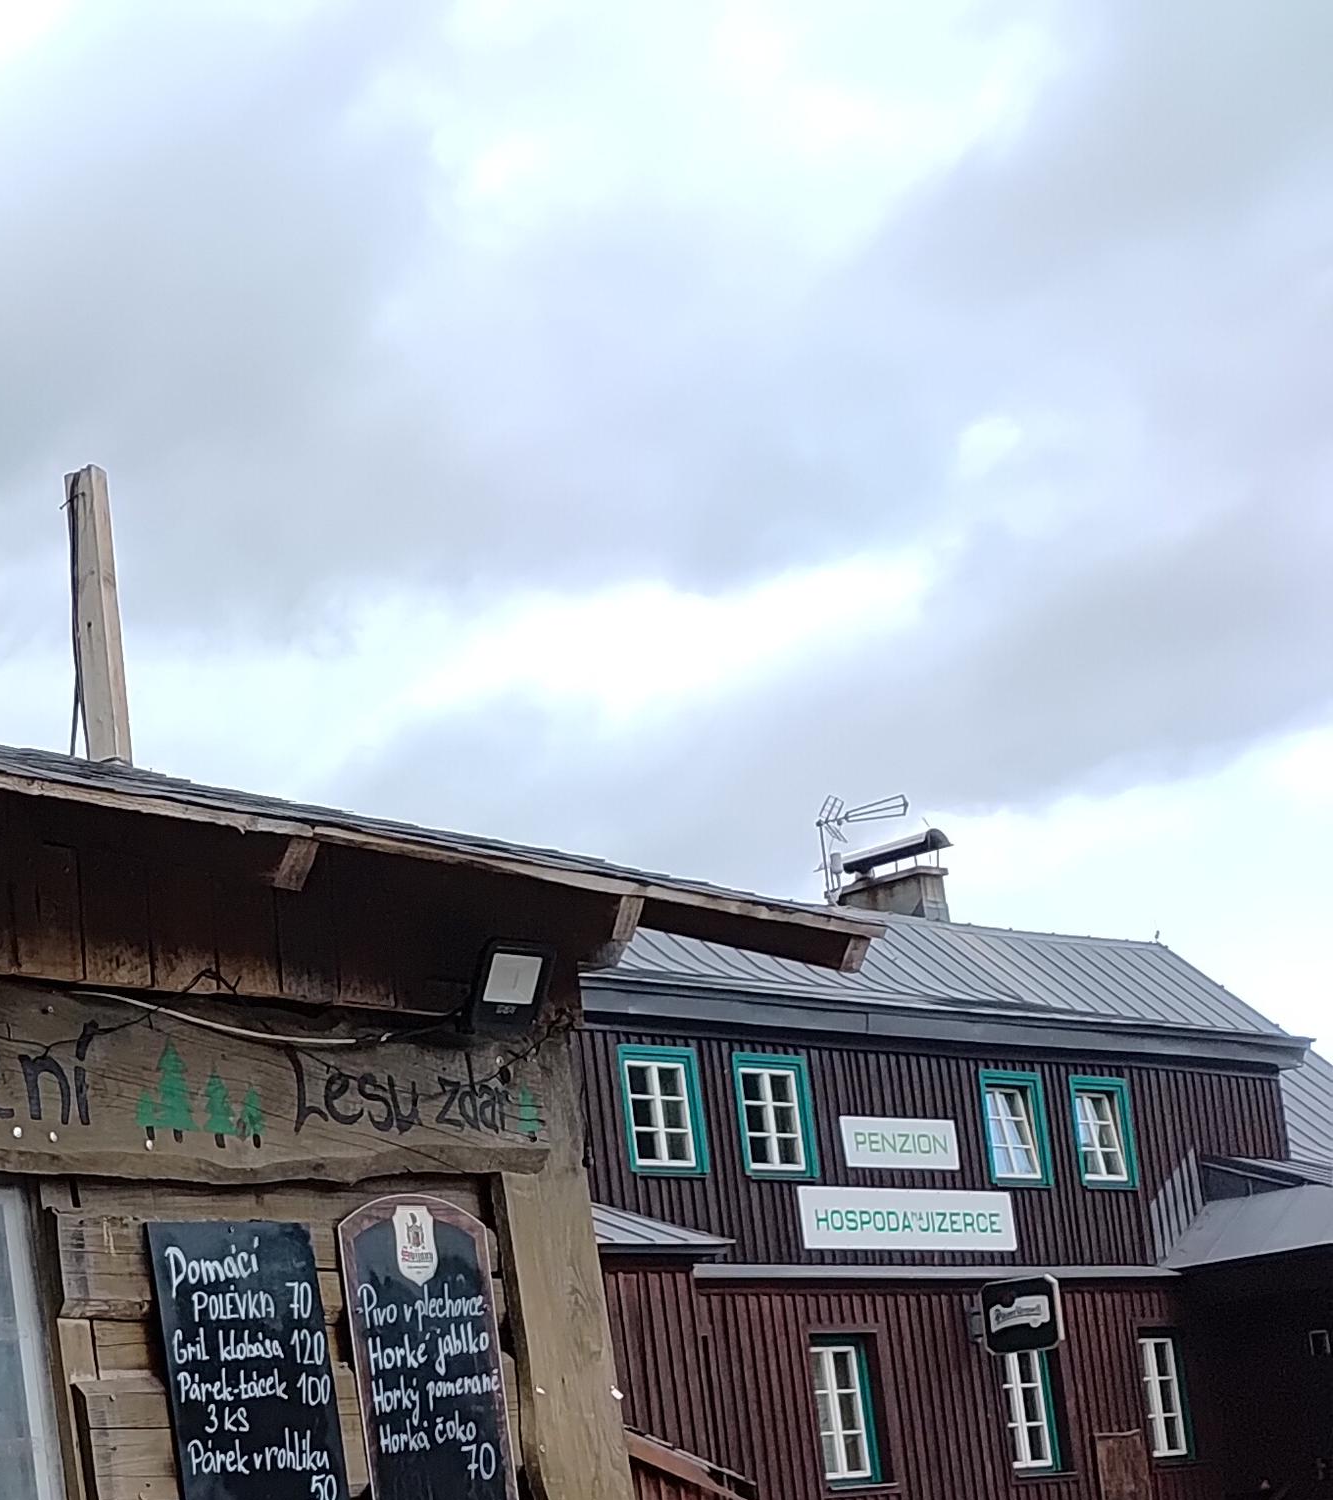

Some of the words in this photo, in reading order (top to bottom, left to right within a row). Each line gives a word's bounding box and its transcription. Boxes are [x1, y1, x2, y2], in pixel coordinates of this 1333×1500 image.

[284, 1044, 423, 1135] Lesu
[853, 1131, 949, 1155] PENZION
[814, 1208, 914, 1232] HOSPODA
[918, 1211, 1003, 1234] JIZERCE
[164, 1236, 259, 1299] Domácí
[192, 1284, 275, 1323] POLÉVKA
[285, 1281, 313, 1320] 70
[357, 1283, 398, 1329] Pivo
[404, 1302, 414, 1323] v
[413, 1283, 485, 1332] plechovce
[219, 1328, 284, 1362] klobása
[290, 1328, 325, 1366] 120
[367, 1331, 431, 1376] Horké
[435, 1321, 490, 1376] jablko
[296, 1371, 331, 1406] 100
[371, 1376, 420, 1426] Horký
[204, 1403, 218, 1434] 3
[379, 1417, 431, 1454] Horká
[434, 1410, 477, 1442] čoko
[187, 1438, 250, 1476] Párek
[253, 1453, 263, 1470] v
[461, 1443, 497, 1480] 70
